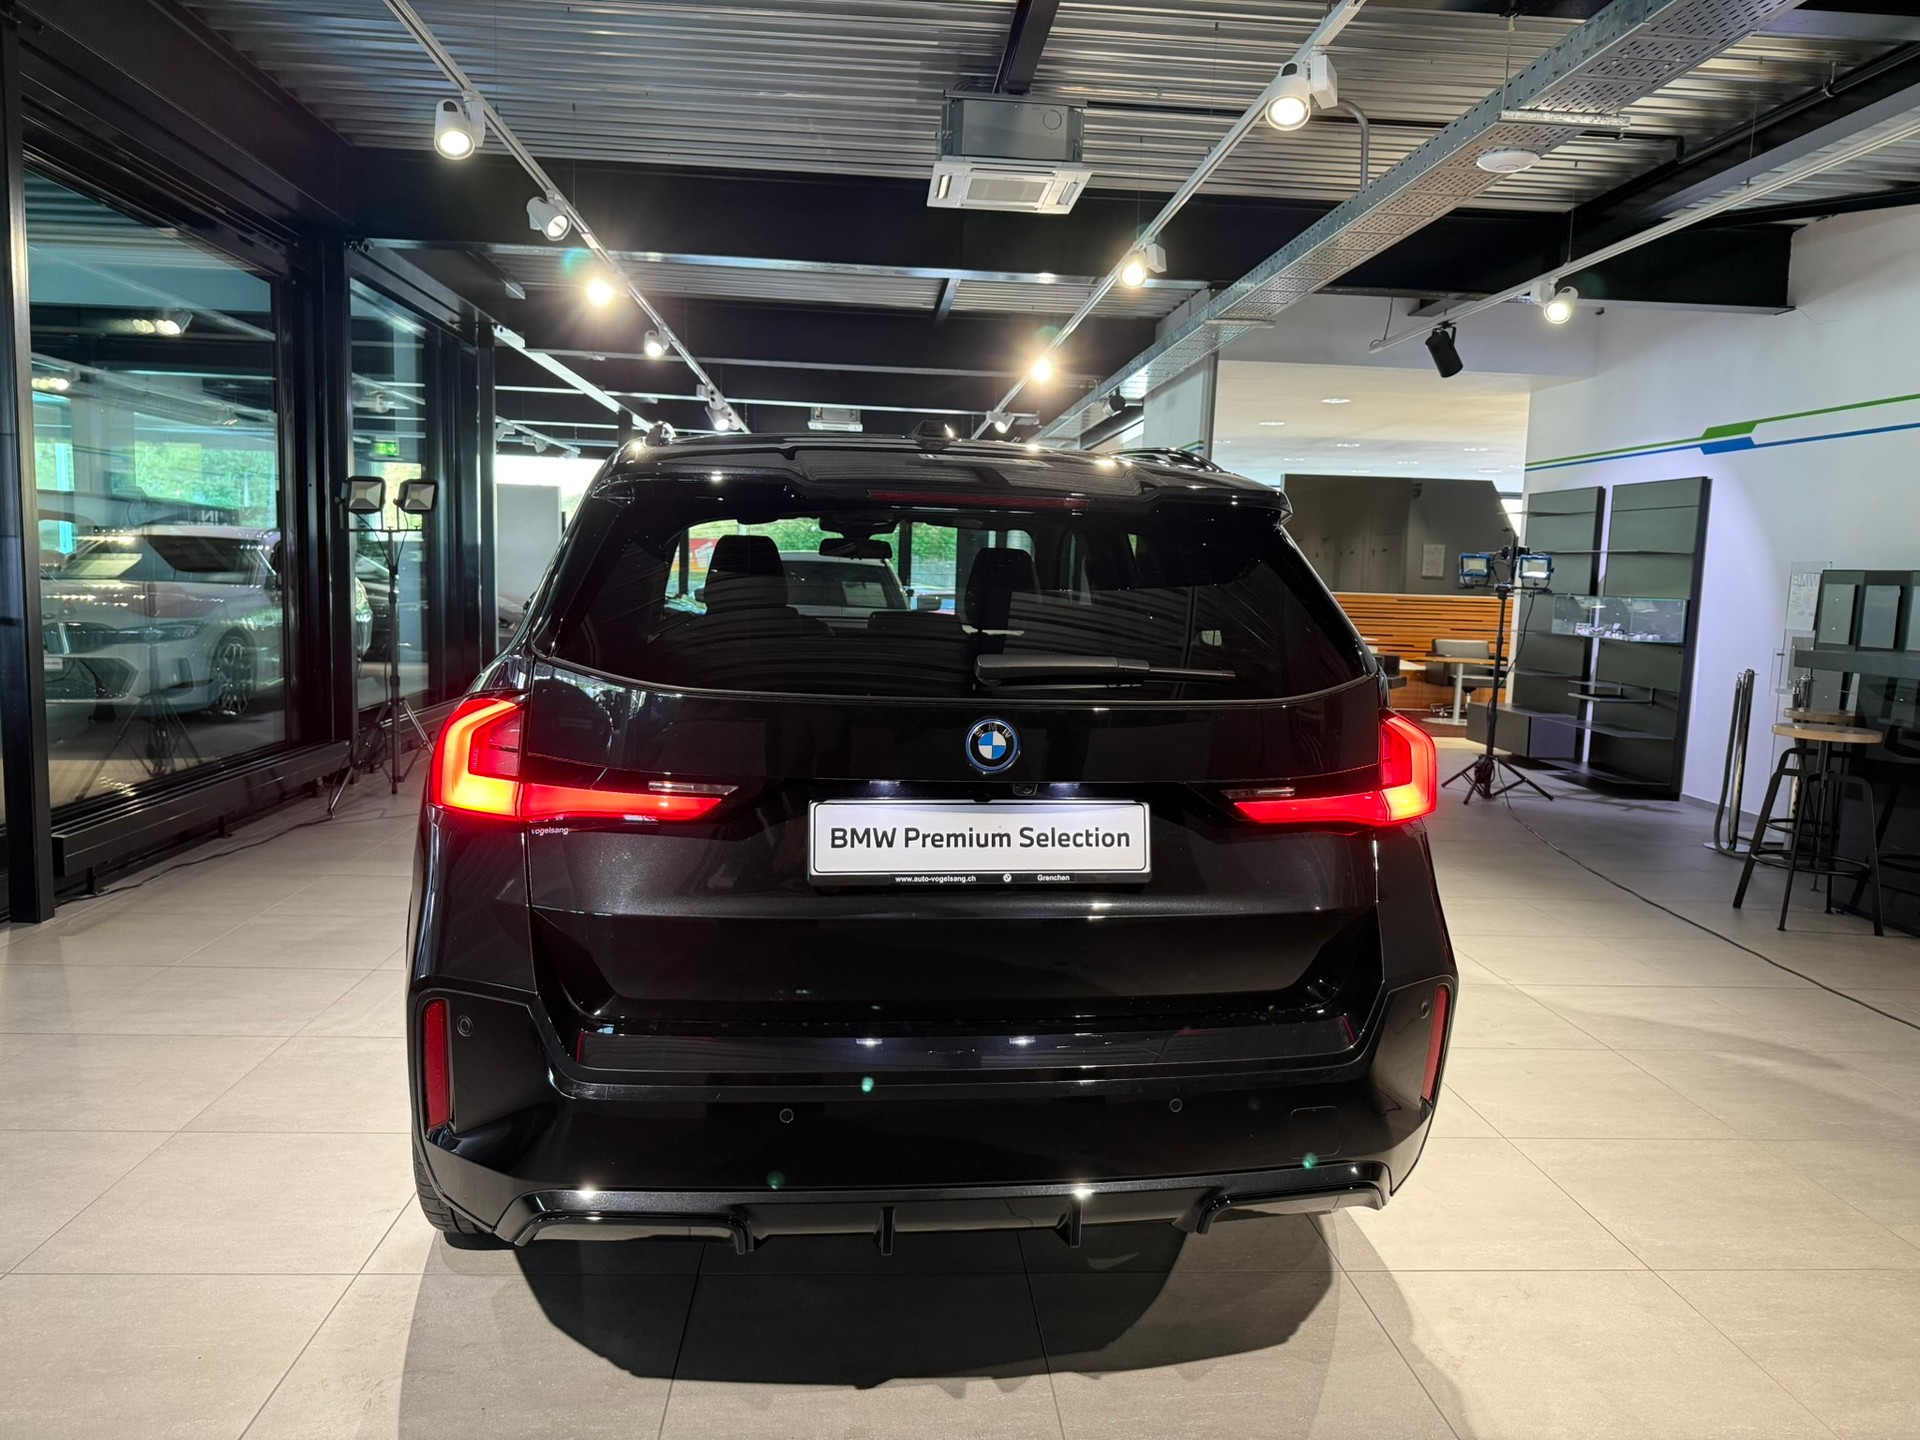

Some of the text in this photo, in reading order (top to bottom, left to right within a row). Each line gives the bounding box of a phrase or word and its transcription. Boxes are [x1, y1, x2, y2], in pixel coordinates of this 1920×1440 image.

[973, 723, 1012, 739] BMW
[830, 826, 1130, 849] BMW Premium Selection
[895, 873, 1070, 884] www.auto-vogelsang.ch Grenchen
